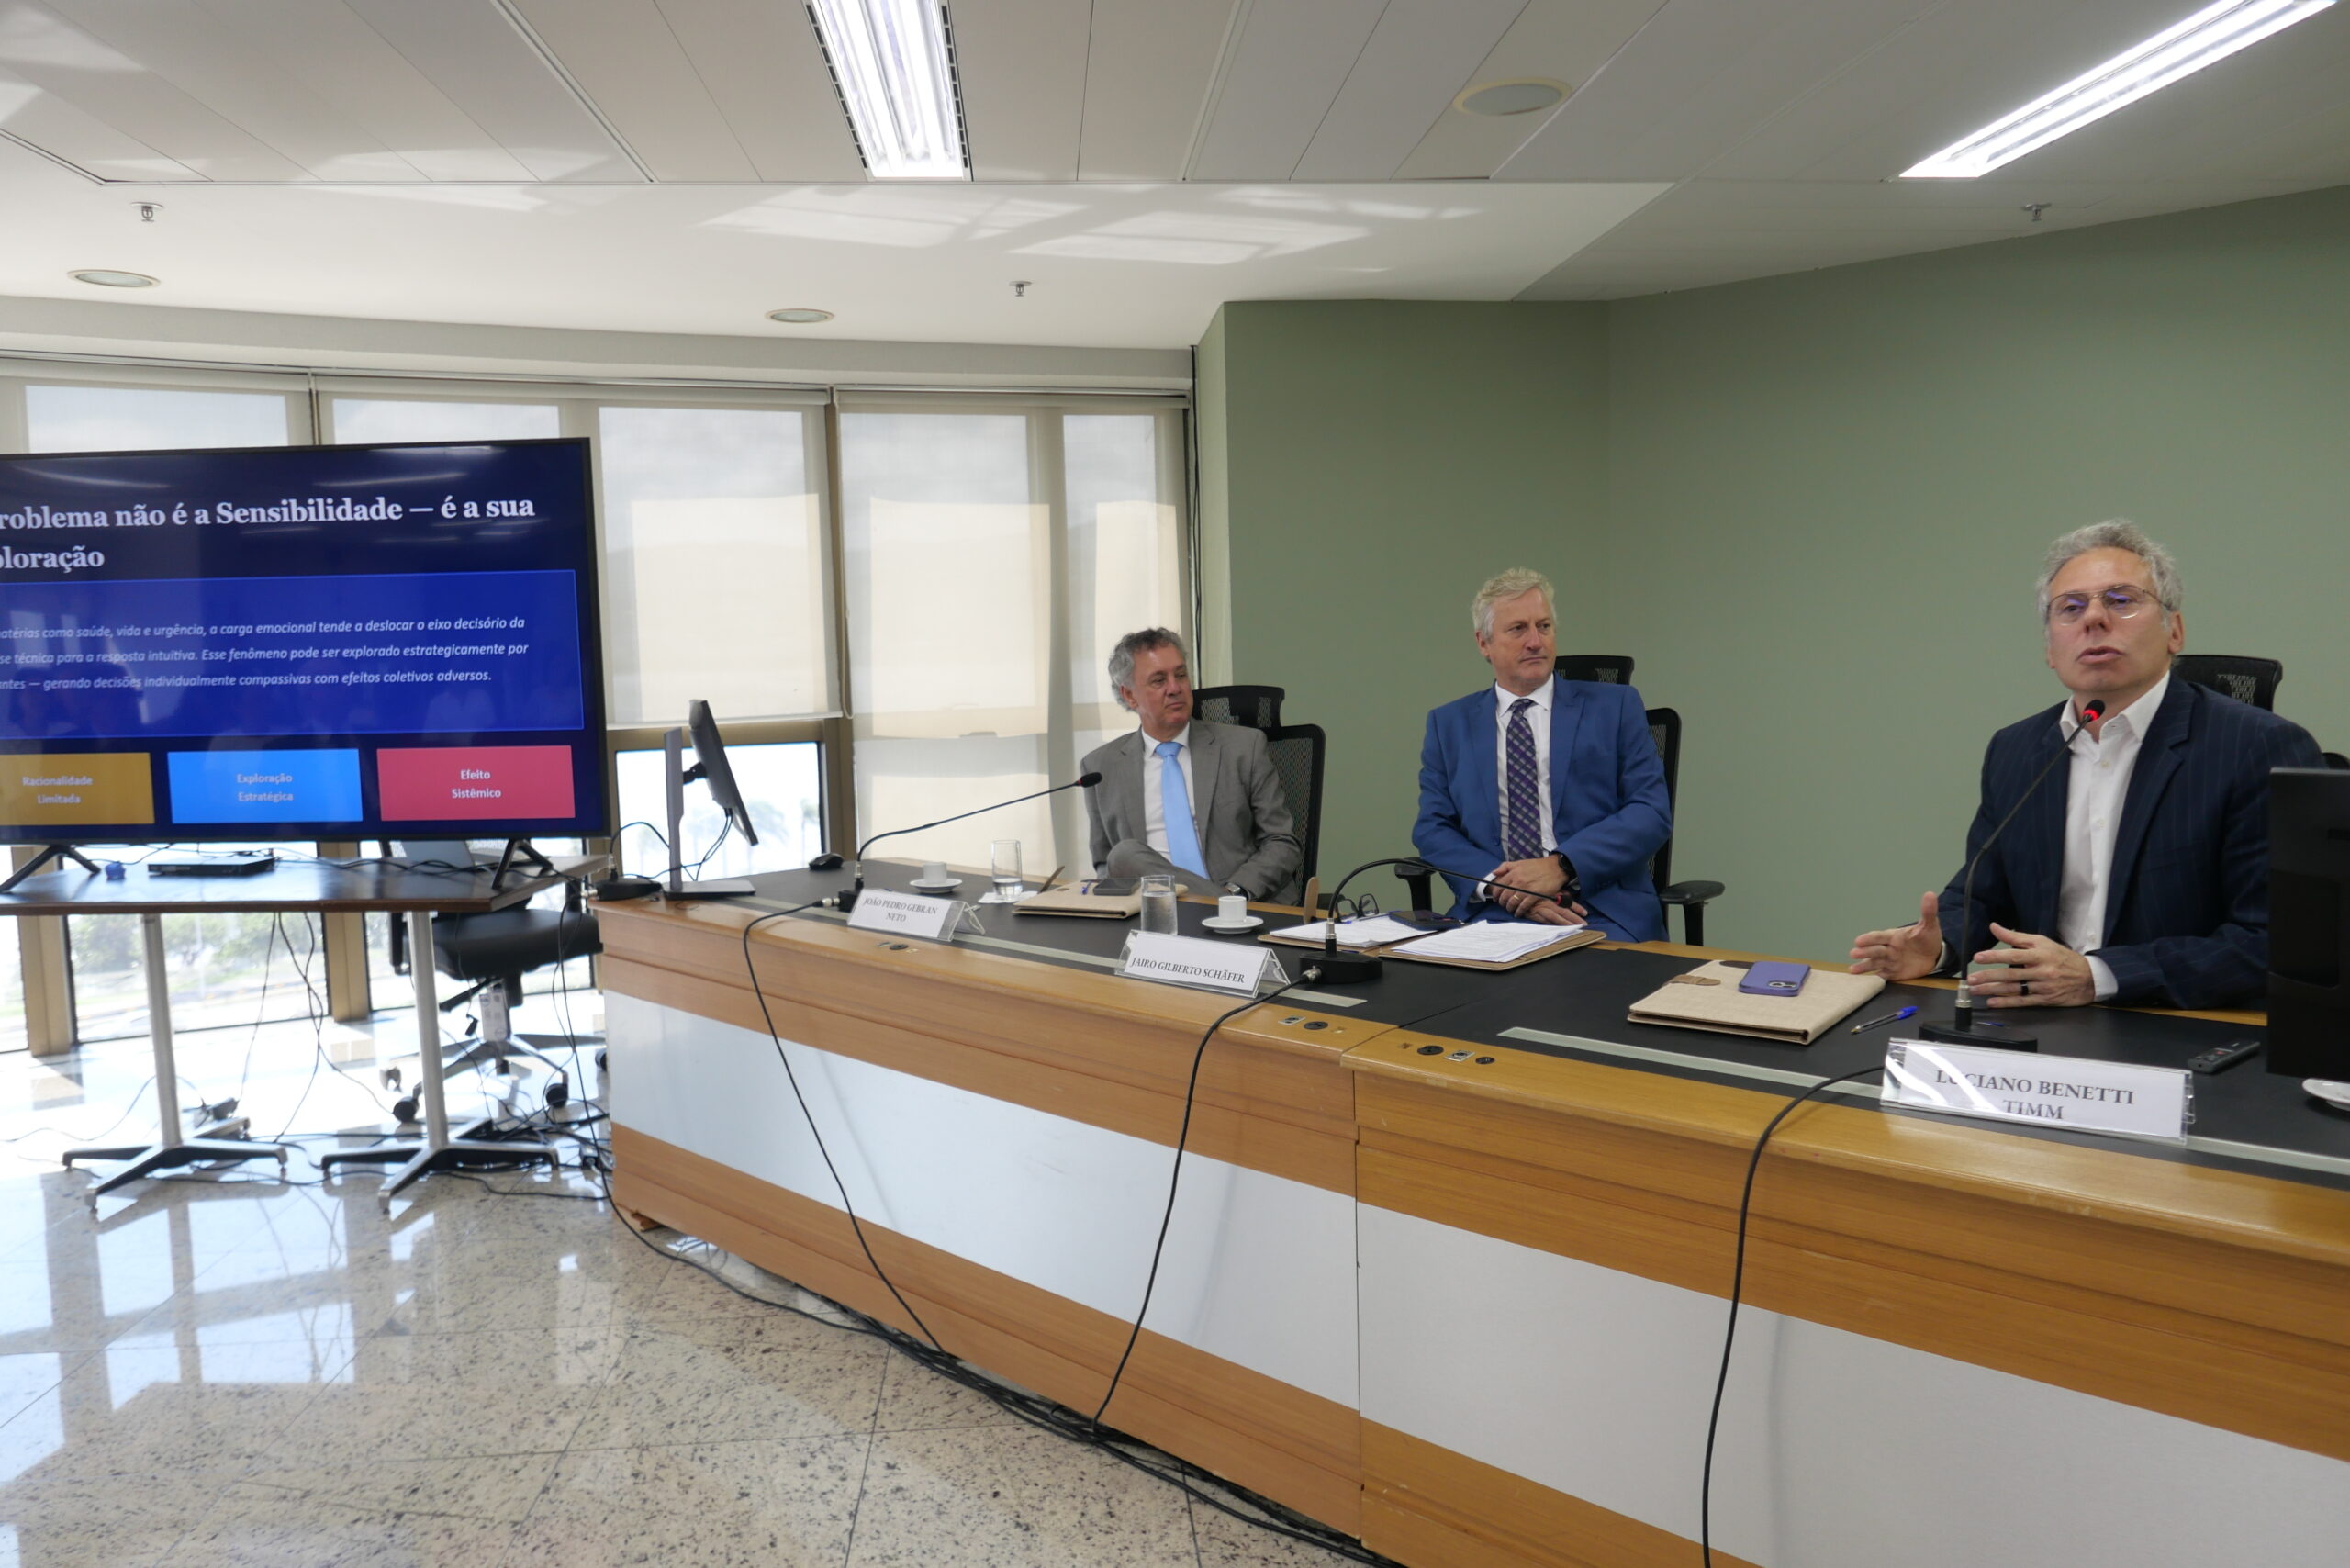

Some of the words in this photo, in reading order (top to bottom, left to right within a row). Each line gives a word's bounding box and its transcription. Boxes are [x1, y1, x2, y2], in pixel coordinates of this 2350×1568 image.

[0, 506, 108, 529] roblema
[115, 504, 166, 527] não
[172, 502, 188, 525] é
[194, 508, 211, 525] a
[216, 497, 403, 524] Sensibilidade
[441, 495, 457, 520] é
[463, 501, 480, 518] a
[486, 498, 536, 518] sua
[0, 628, 40, 638] atérias
[42, 628, 73, 637] como
[76, 625, 113, 638] saúde,
[117, 625, 140, 636] vida
[143, 627, 150, 635] e
[153, 623, 207, 638] urgência,
[210, 625, 218, 634] a
[220, 624, 253, 636] carga
[256, 622, 316, 634] emocional
[319, 621, 352, 633] tende
[355, 622, 363, 632] a
[365, 620, 415, 631] deslocar
[417, 621, 425, 630] o
[428, 618, 452, 630] eixo
[454, 617, 507, 630] decisório
[509, 617, 525, 628] da
[14, 653, 54, 664] técnica
[57, 654, 84, 665] para
[86, 654, 94, 662] a
[96, 652, 145, 665] resposta
[148, 650, 197, 661] intuitiva.
[202, 649, 226, 660] Esse
[228, 647, 287, 662] fenômeno
[290, 647, 319, 660] pode
[322, 649, 340, 657] ser
[342, 644, 400, 660] explorado
[403, 644, 505, 658] estrategicamente
[508, 644, 529, 656] por
[44, 678, 91, 691] gerando
[94, 677, 141, 688] decisões
[144, 676, 236, 688] individualmente
[239, 673, 311, 687] compassivas
[315, 674, 339, 684] com
[341, 671, 380, 685] efeitos
[384, 671, 433, 682] coletivos
[437, 670, 492, 681] adversos.
[22, 775, 93, 786] Racionalidade
[237, 773, 293, 784] Exploração
[461, 769, 491, 780] Efeito
[38, 793, 81, 804] Limitada
[238, 790, 294, 802] Estratégica
[452, 788, 501, 798] Sistêmico
[864, 897, 881, 906] JOÃO
[881, 900, 907, 911] PEDRO
[907, 903, 937, 914] GEBRAN
[885, 913, 907, 922] NETO
[1131, 958, 1157, 969] JAIRO
[1158, 961, 1202, 976] GILBERTO
[2038, 1081, 2134, 1104] BENETTI
[2003, 1099, 2064, 1119] TIMM
